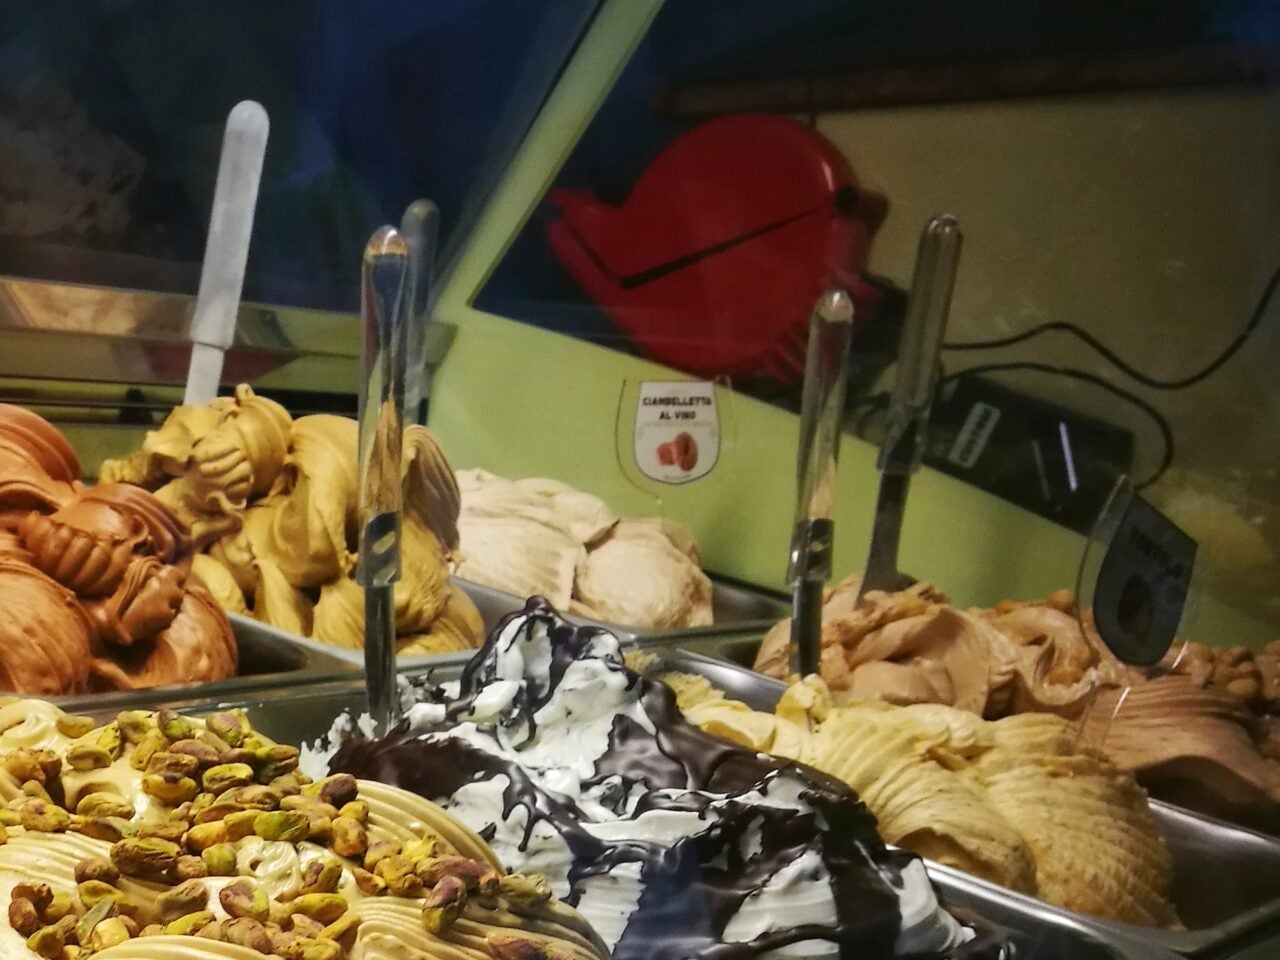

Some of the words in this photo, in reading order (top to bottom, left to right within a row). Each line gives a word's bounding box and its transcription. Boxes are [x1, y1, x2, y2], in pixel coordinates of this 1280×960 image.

[642, 396, 712, 407] CIAMBELLETTA
[659, 411, 671, 420] AL
[675, 411, 696, 420] VINO
